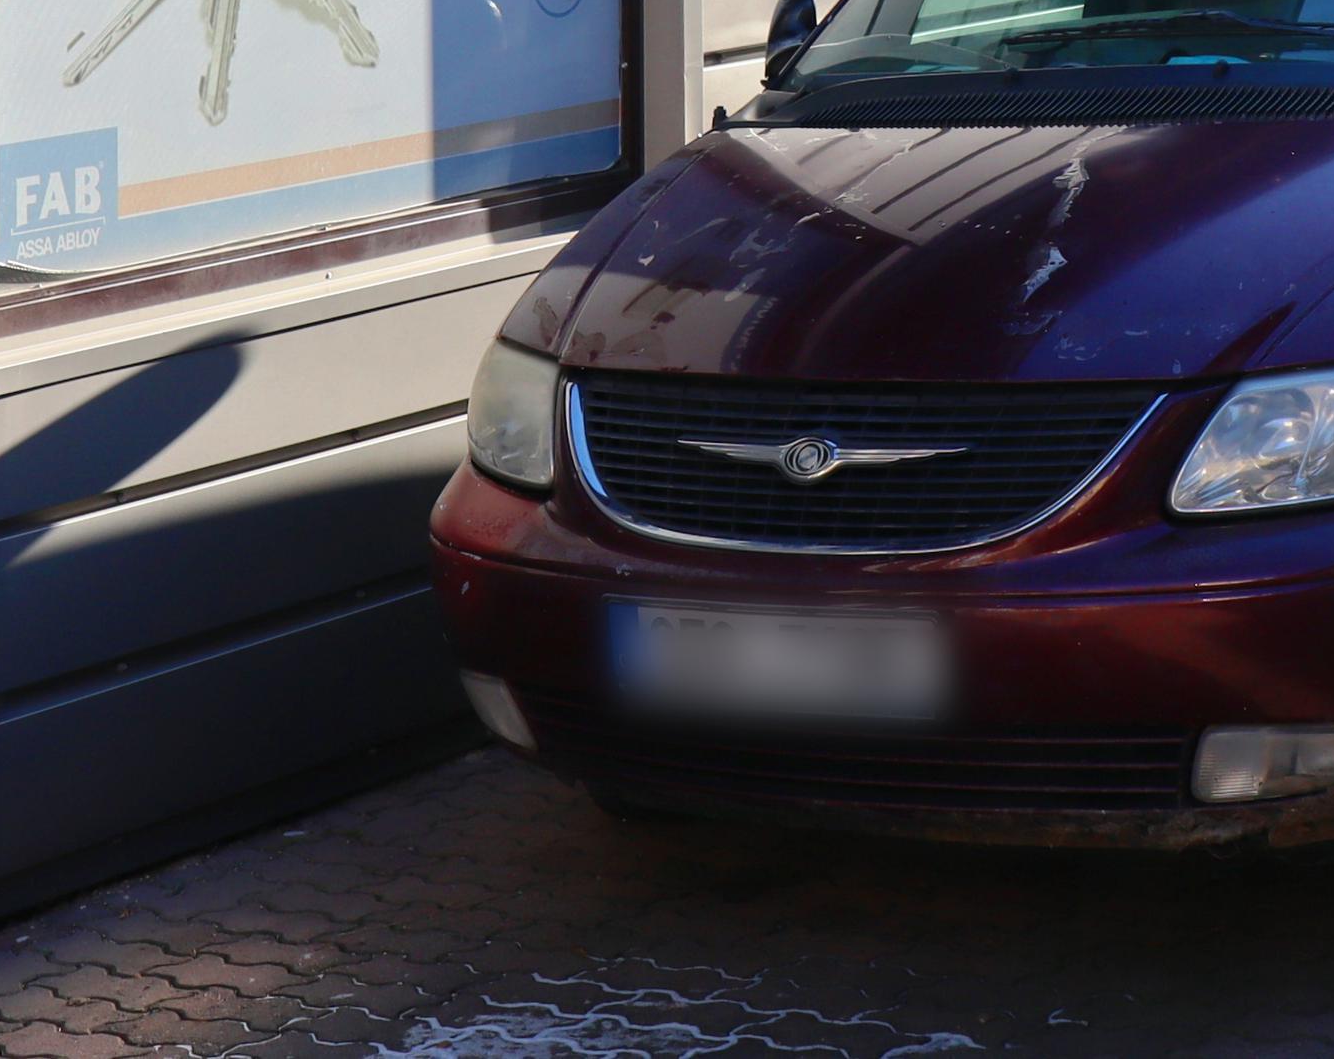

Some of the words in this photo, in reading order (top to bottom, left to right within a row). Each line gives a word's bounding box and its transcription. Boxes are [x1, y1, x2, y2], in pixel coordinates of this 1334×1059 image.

[16, 166, 101, 227] FAB
[16, 236, 54, 260] ASSA
[55, 227, 101, 253] ABLOY
